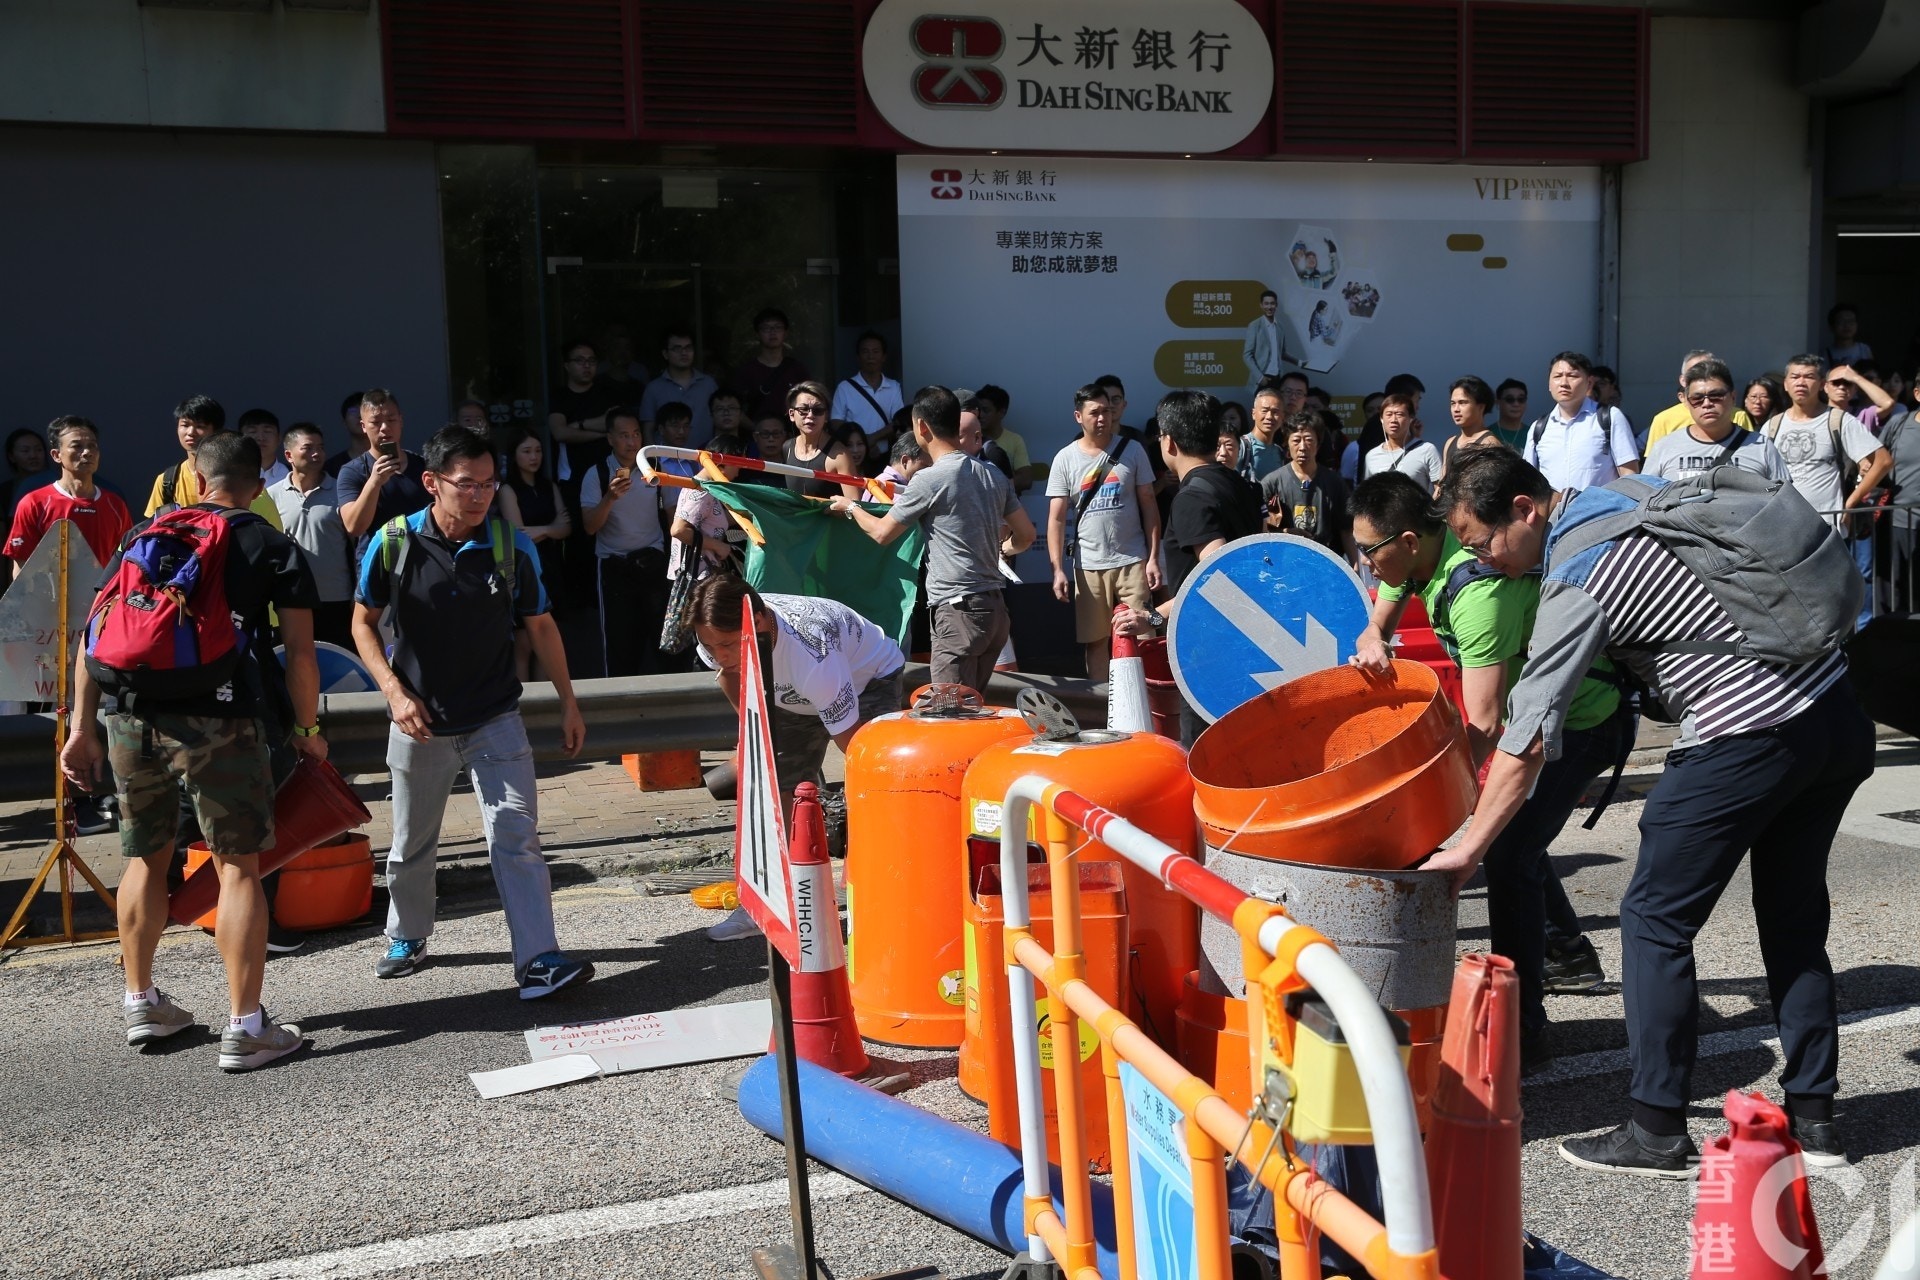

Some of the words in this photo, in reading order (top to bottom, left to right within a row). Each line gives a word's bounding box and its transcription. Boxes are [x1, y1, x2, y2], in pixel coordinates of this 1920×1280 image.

[1016, 23, 1232, 73] 大新銀行
[1017, 79, 1082, 110] DAH
[1085, 81, 1154, 111] SING
[1155, 84, 1232, 113] BANK
[968, 168, 1057, 186] 大新銀行
[1473, 178, 1519, 200] VIP
[1521, 179, 1572, 189] BANKING
[1521, 190, 1572, 201] 銀行服務
[996, 231, 1103, 249] 專業財策方案
[1012, 255, 1118, 274] 助您成就夢想
